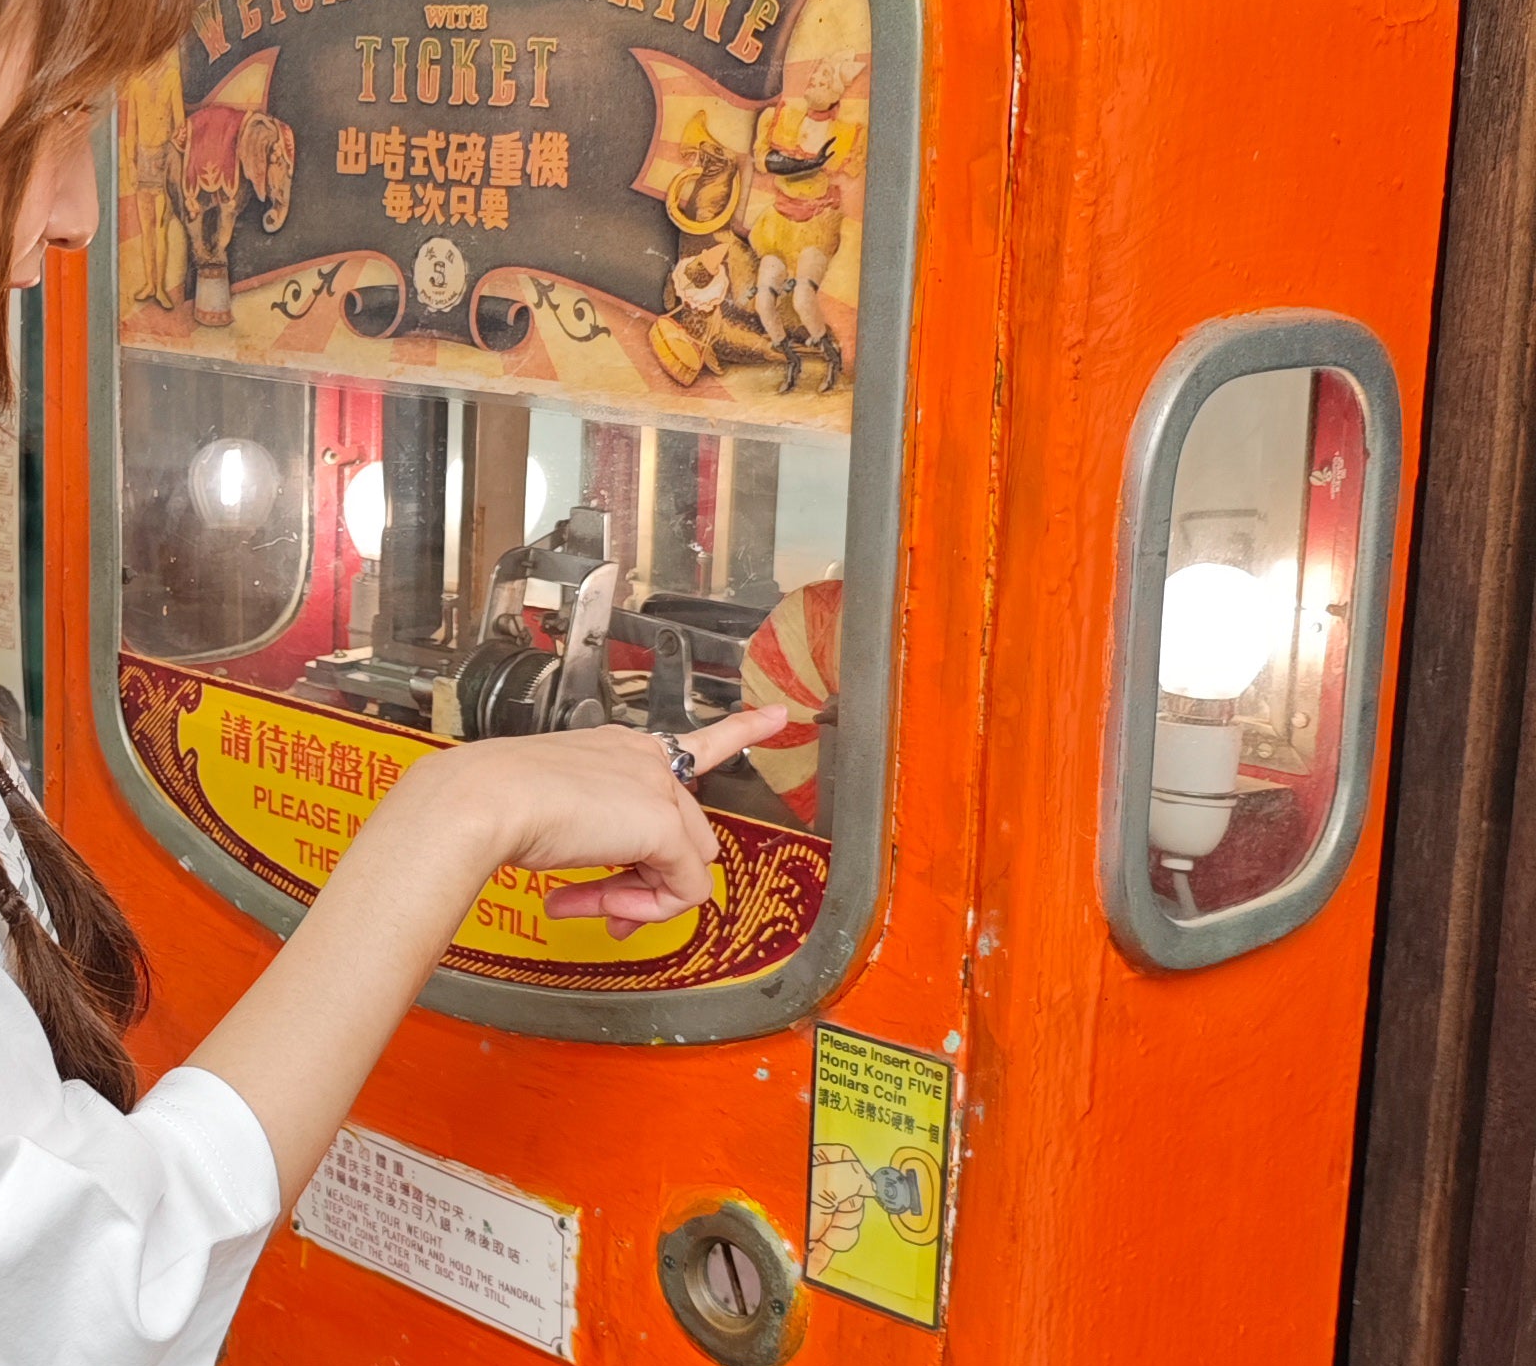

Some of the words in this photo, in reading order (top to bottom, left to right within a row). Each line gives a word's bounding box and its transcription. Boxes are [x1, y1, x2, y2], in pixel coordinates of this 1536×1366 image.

[424, 3, 489, 30] WITH
[355, 36, 558, 108] TICKET
[336, 126, 570, 188] 出咭式磅重機
[382, 181, 509, 231] 每次只要
[221, 709, 410, 801] 請待輪盤停
[253, 785, 341, 836] PLEASE
[294, 838, 340, 874] THE
[476, 898, 548, 946] STILL
[819, 1050, 859, 1077] Hong
[864, 1063, 903, 1090] Kong
[908, 1077, 943, 1101] FIVE
[820, 1032, 868, 1058] Please
[913, 1061, 944, 1082] One
[819, 1067, 869, 1095] Dollars
[873, 1084, 907, 1107] Coin
[324, 1198, 344, 1215] STEP
[347, 1210, 358, 1223] ON
[362, 1216, 378, 1232] THE
[382, 1226, 424, 1254] PLATFORM
[428, 1248, 445, 1264] AND
[449, 1257, 472, 1276] HOLD
[476, 1268, 494, 1286] THE
[324, 1223, 345, 1243] THEN
[348, 1236, 365, 1252] GET
[368, 1245, 384, 1261] THE
[326, 1186, 369, 1216] MEASURE
[375, 1208, 401, 1230] YOUR
[406, 1222, 443, 1248] WEIGHT
[324, 1212, 352, 1233] INSERT
[355, 1226, 380, 1247] COINS
[383, 1240, 410, 1260] AFTER
[414, 1254, 430, 1271] THE
[434, 1263, 455, 1282] DISC
[459, 1276, 480, 1293] STAY
